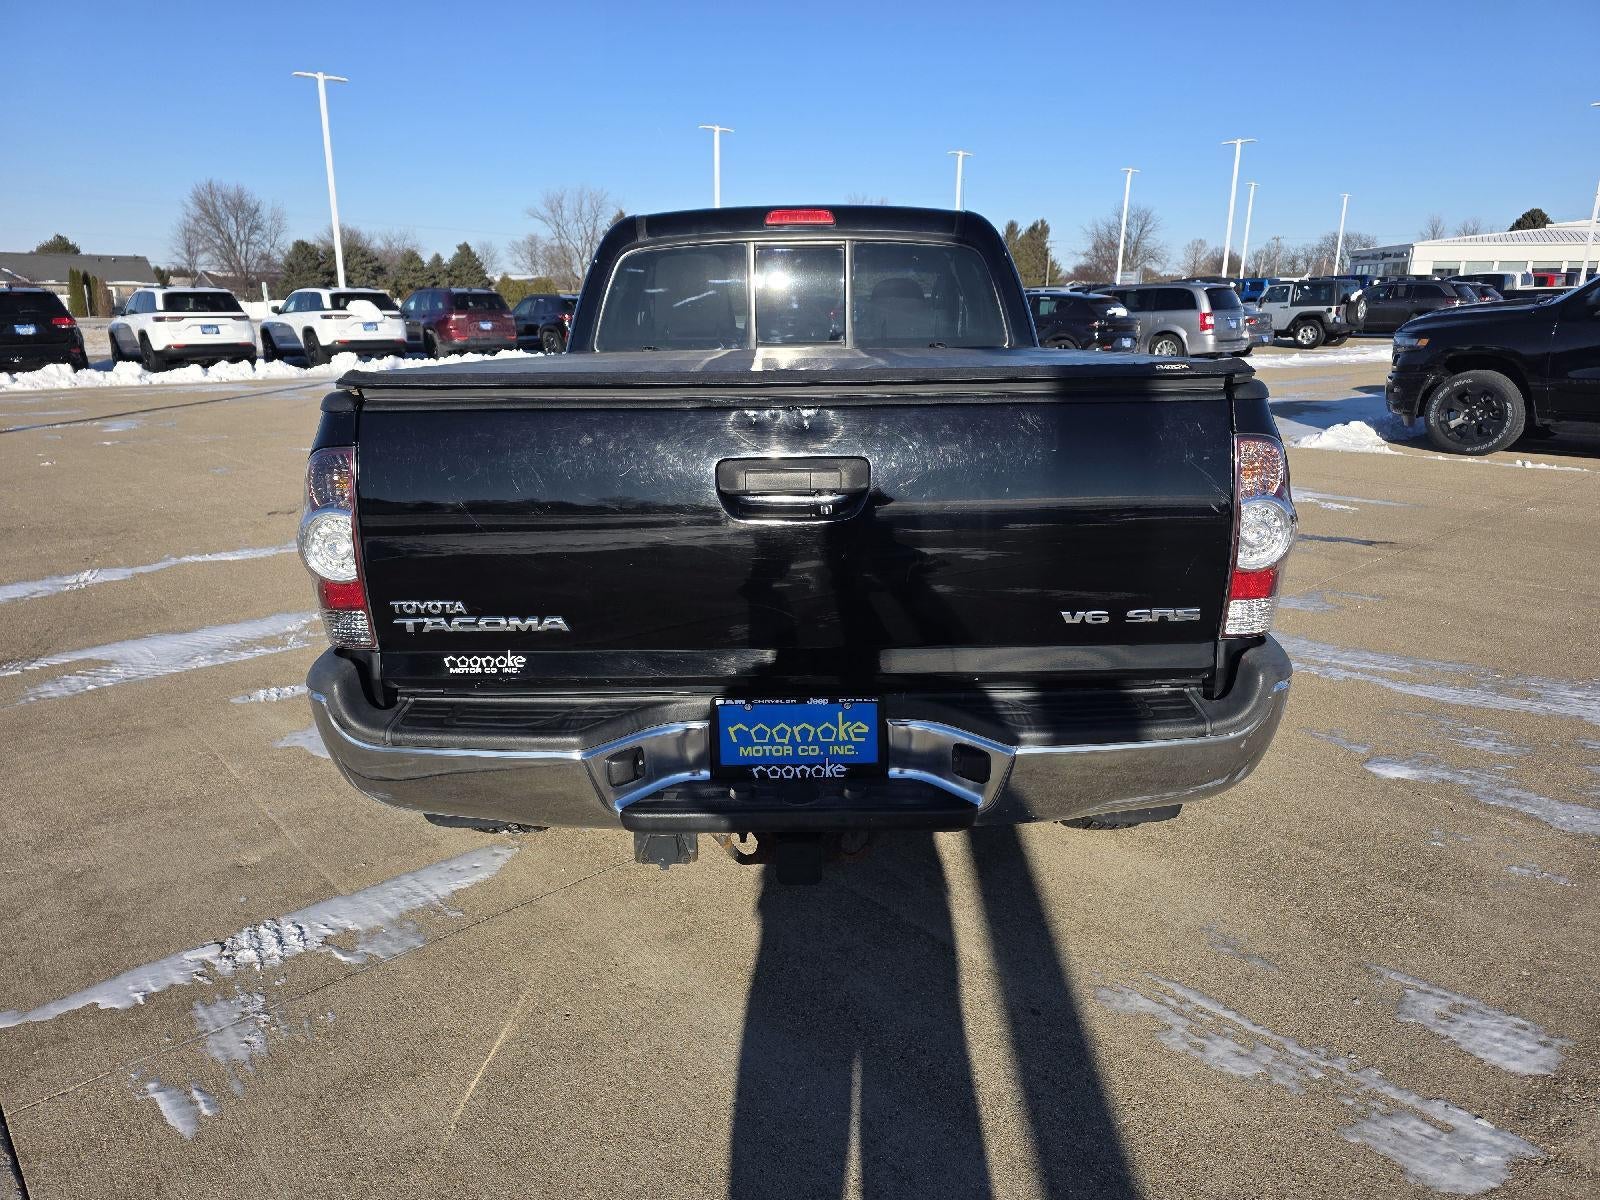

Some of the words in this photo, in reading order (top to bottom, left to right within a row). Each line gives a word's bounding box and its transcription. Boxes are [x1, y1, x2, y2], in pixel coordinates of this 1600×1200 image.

[389, 599, 467, 615] TOYOTA
[392, 615, 570, 633] TACOMA
[1061, 610, 1110, 624] V6
[1125, 608, 1201, 622] SR5
[806, 697, 829, 706] Jeep
[727, 711, 869, 744] roanoke
[739, 746, 793, 756] MOTOR
[798, 745, 824, 756] CO.
[829, 745, 859, 755] INC.
